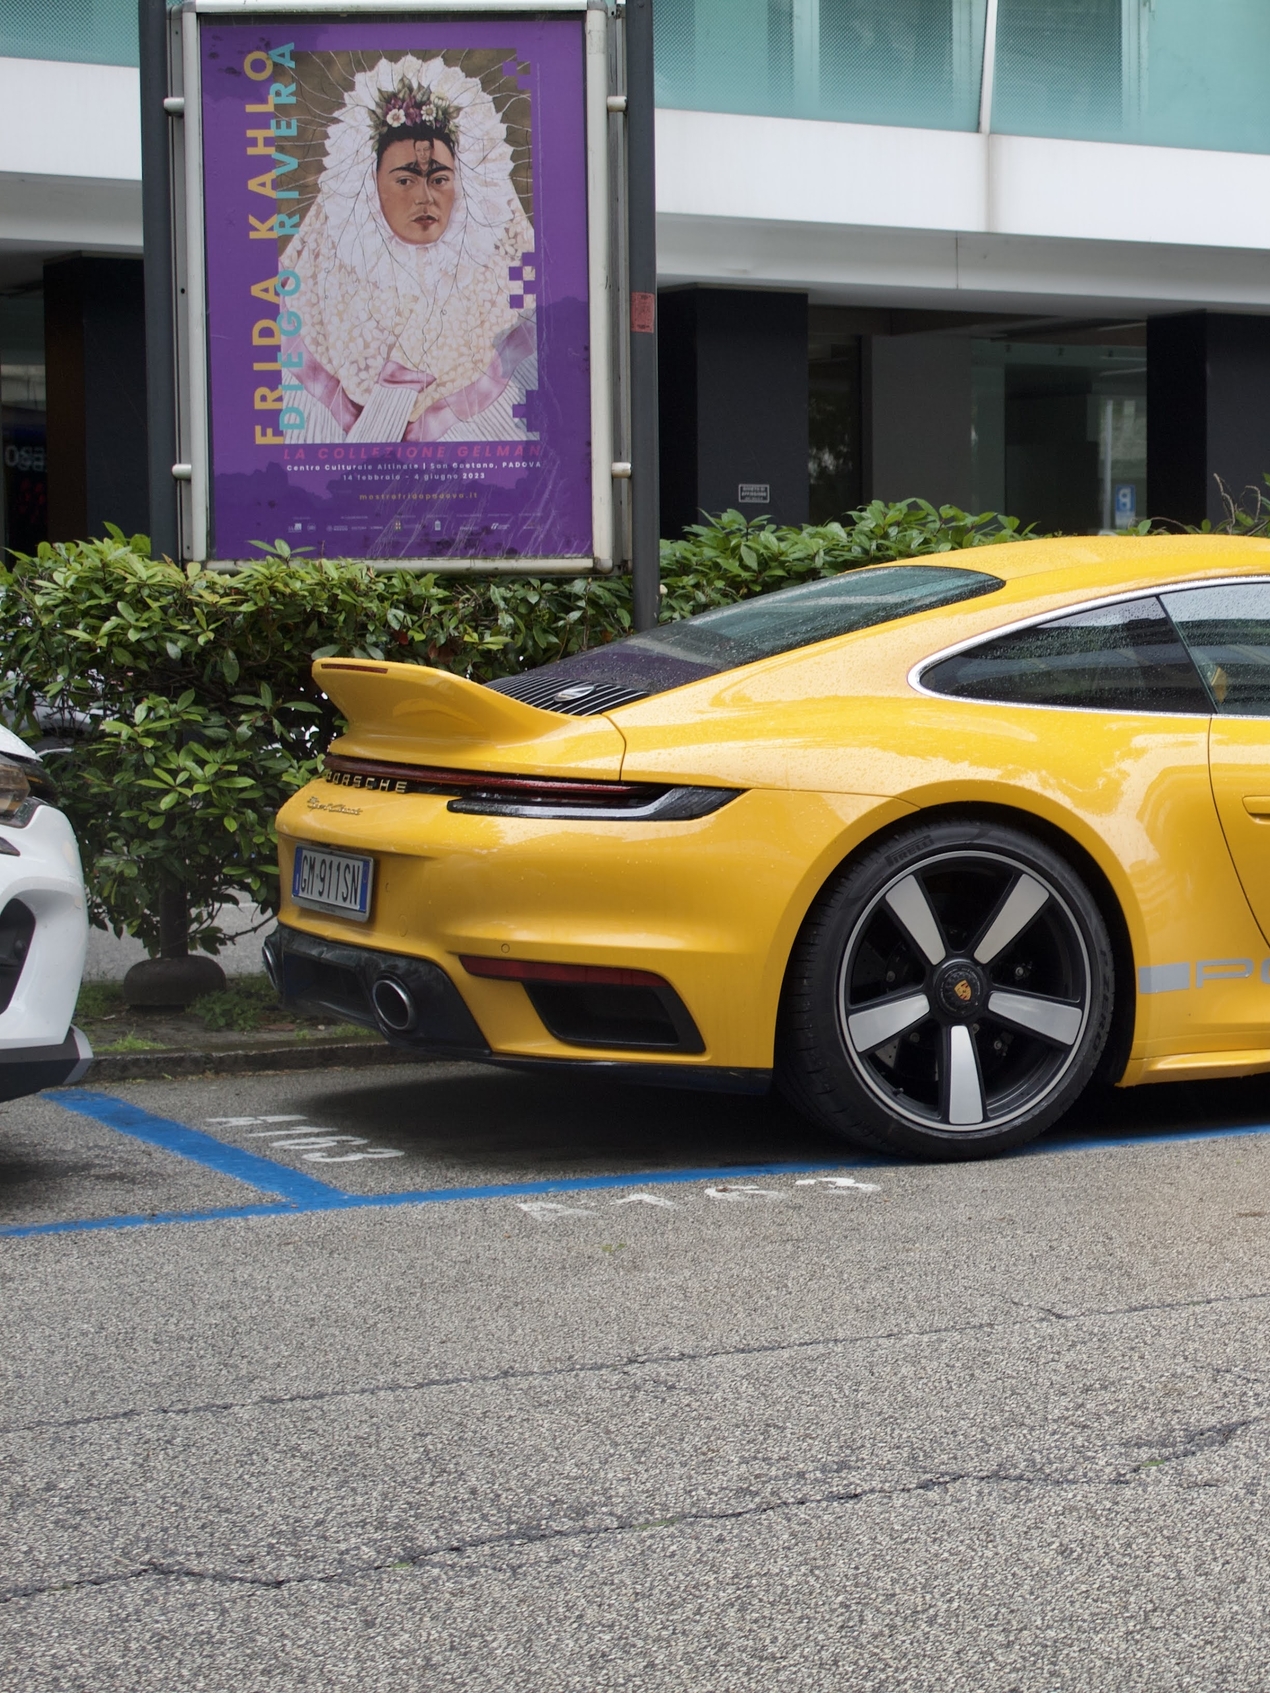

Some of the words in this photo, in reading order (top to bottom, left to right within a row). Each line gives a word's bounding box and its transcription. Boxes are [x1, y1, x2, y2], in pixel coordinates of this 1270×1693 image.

[243, 50, 279, 239] KAHLO
[268, 42, 300, 236] RIVERA
[250, 275, 285, 445] FRIDA
[275, 269, 306, 430] DIEGO
[283, 448, 305, 460] LA
[317, 446, 445, 460] COLLEZIONE
[457, 445, 540, 457] GELMAN
[286, 464, 320, 472] Centro
[325, 463, 373, 471] Culturale
[377, 462, 419, 470] Altinate
[430, 462, 448, 470] San
[502, 461, 541, 469] PADOVA
[357, 473, 400, 481] febbraio
[423, 472, 458, 482] giugno
[462, 472, 485, 480] 2023
[325, 771, 408, 793] PORSCHE
[884, 834, 936, 867] PIRELLI
